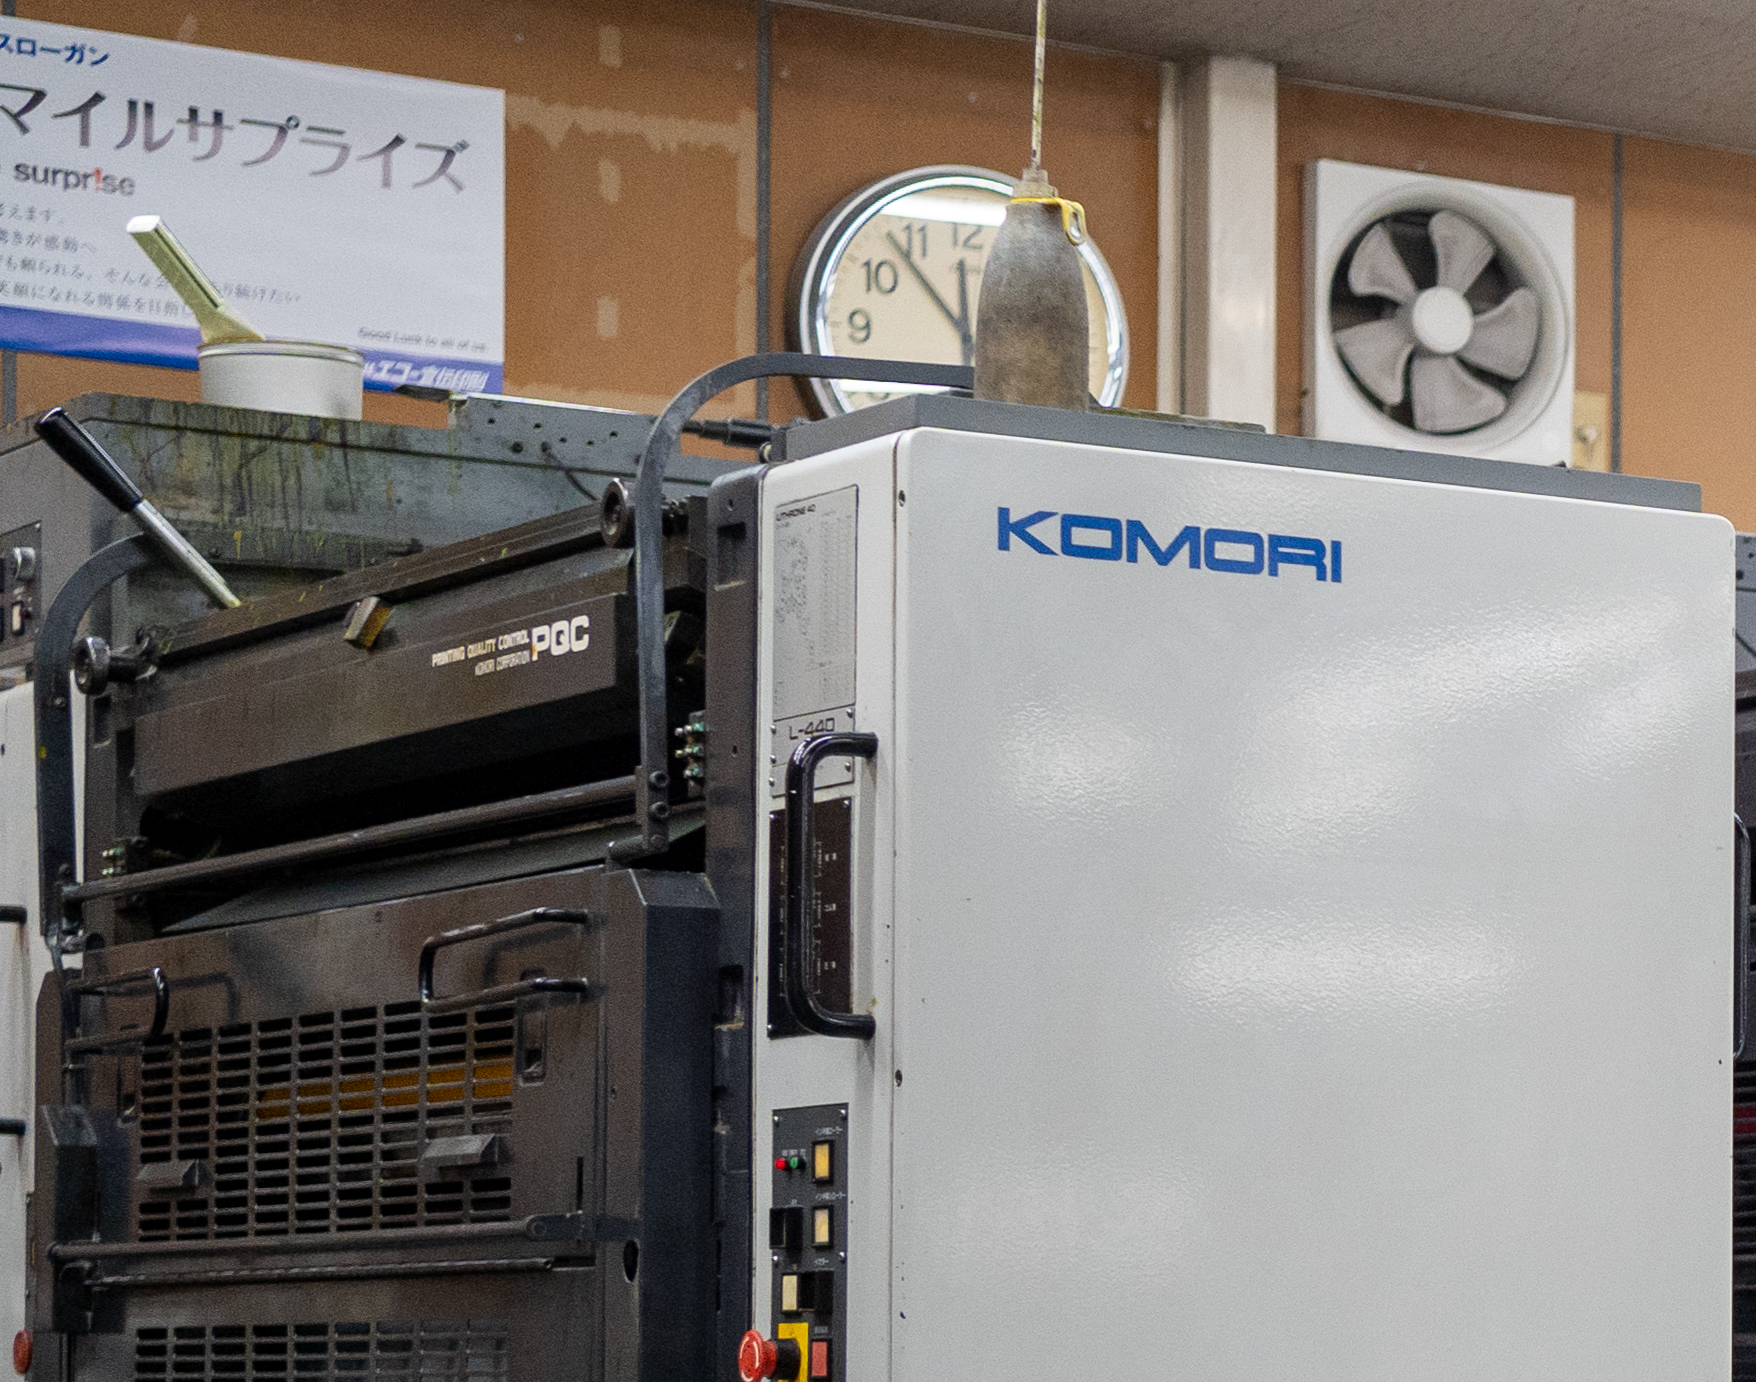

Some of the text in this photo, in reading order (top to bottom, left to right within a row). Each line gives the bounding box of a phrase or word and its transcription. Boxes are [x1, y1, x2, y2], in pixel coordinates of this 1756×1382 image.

[902, 222, 928, 258] 11
[952, 222, 984, 250] 12
[862, 257, 898, 295] 10
[848, 307, 872, 344] 9
[997, 506, 1343, 583] KOMORI
[532, 615, 590, 661] PQC
[789, 717, 836, 740] L-440
